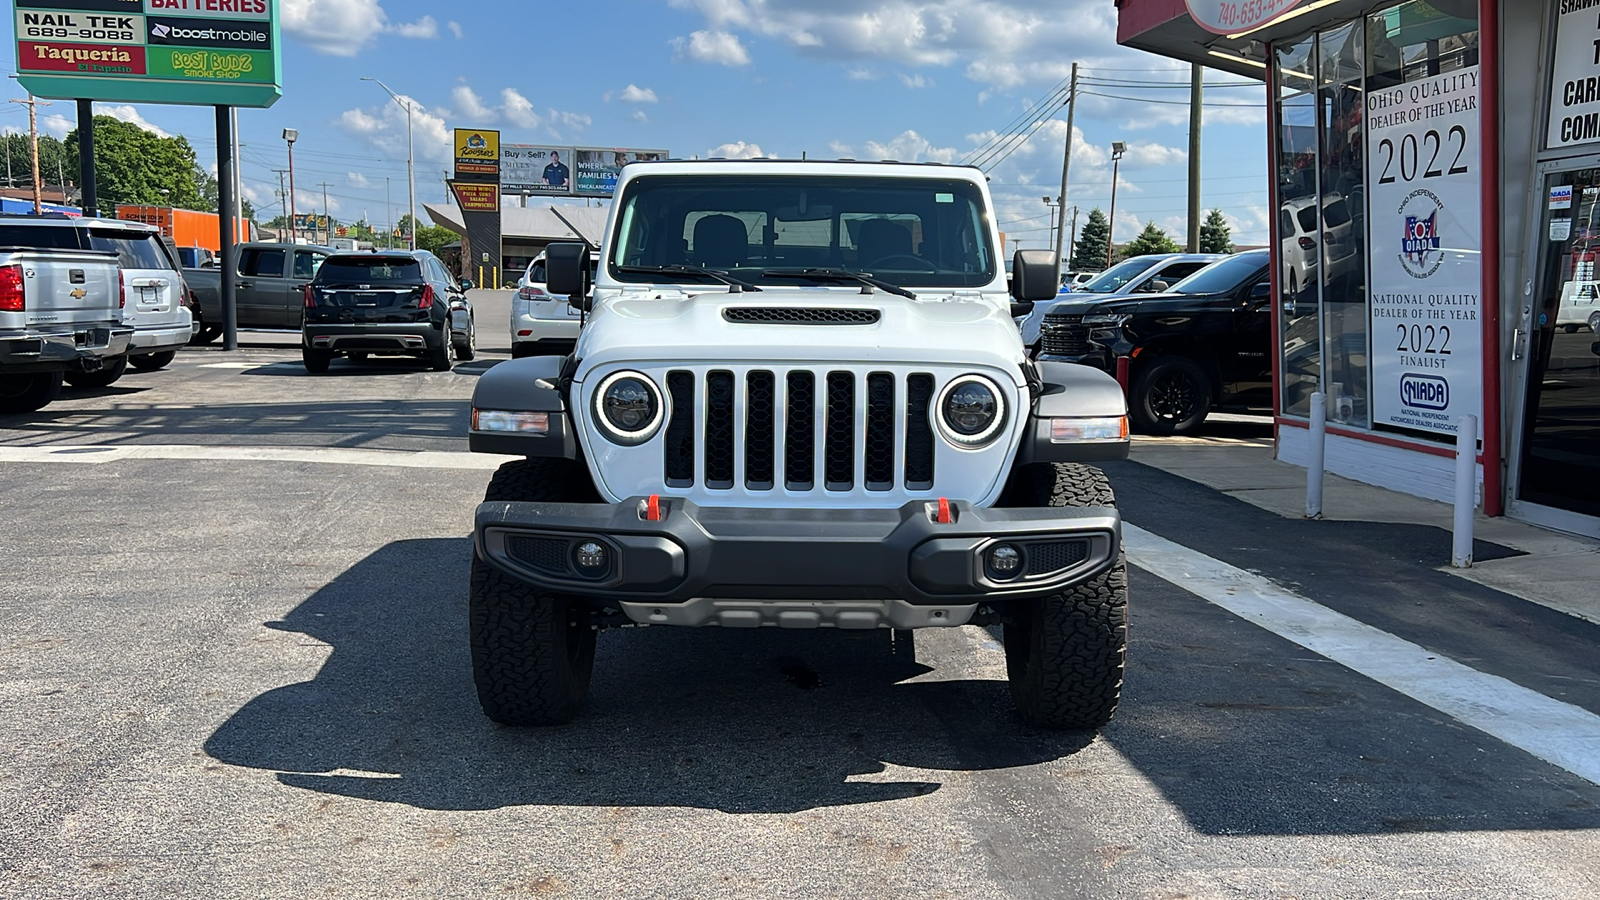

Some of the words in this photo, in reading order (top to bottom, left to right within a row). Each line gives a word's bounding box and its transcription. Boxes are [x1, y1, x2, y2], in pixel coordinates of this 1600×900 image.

[24, 13, 77, 26] NAIL
[86, 16, 134, 29] TEK
[1218, 0, 1283, 26] 740-653-4
[27, 27, 134, 40] 689-9088
[34, 45, 131, 64] Taqueria
[78, 63, 88, 71] El
[92, 64, 132, 73] Tapatio
[184, 70, 214, 78] SMOKE
[216, 70, 240, 79] SHOP
[1368, 90, 1403, 110] OHIO
[1410, 71, 1478, 103] QUALITY
[1563, 75, 1600, 107] CAR
[1370, 110, 1406, 130] DEALER
[1408, 107, 1421, 122] OF
[1424, 102, 1444, 118] THE
[1448, 95, 1476, 114] YEAR
[1561, 113, 1600, 142] COM
[459, 146, 494, 157] Roosters
[1378, 124, 1468, 184] 2022
[1398, 196, 1410, 214] OHIO
[1409, 188, 1444, 210] INDEPENDENT
[1406, 238, 1433, 252] OIADA
[1373, 294, 1424, 304] NATIONAL
[1428, 295, 1478, 306] QUALITY
[1374, 308, 1408, 318] DEALER
[1412, 309, 1422, 318] OF
[1427, 310, 1446, 319] THE
[1450, 310, 1476, 320] YEAR
[1397, 324, 1451, 354] 2022
[1400, 356, 1446, 368] FINALIST
[1404, 380, 1444, 403] NIADA
[1390, 416, 1414, 425] AUTOMOBILE
[1415, 419, 1432, 428] DEALERS
[1401, 409, 1420, 417] NATIONAL
[1421, 412, 1449, 420] INDEPENDENT
